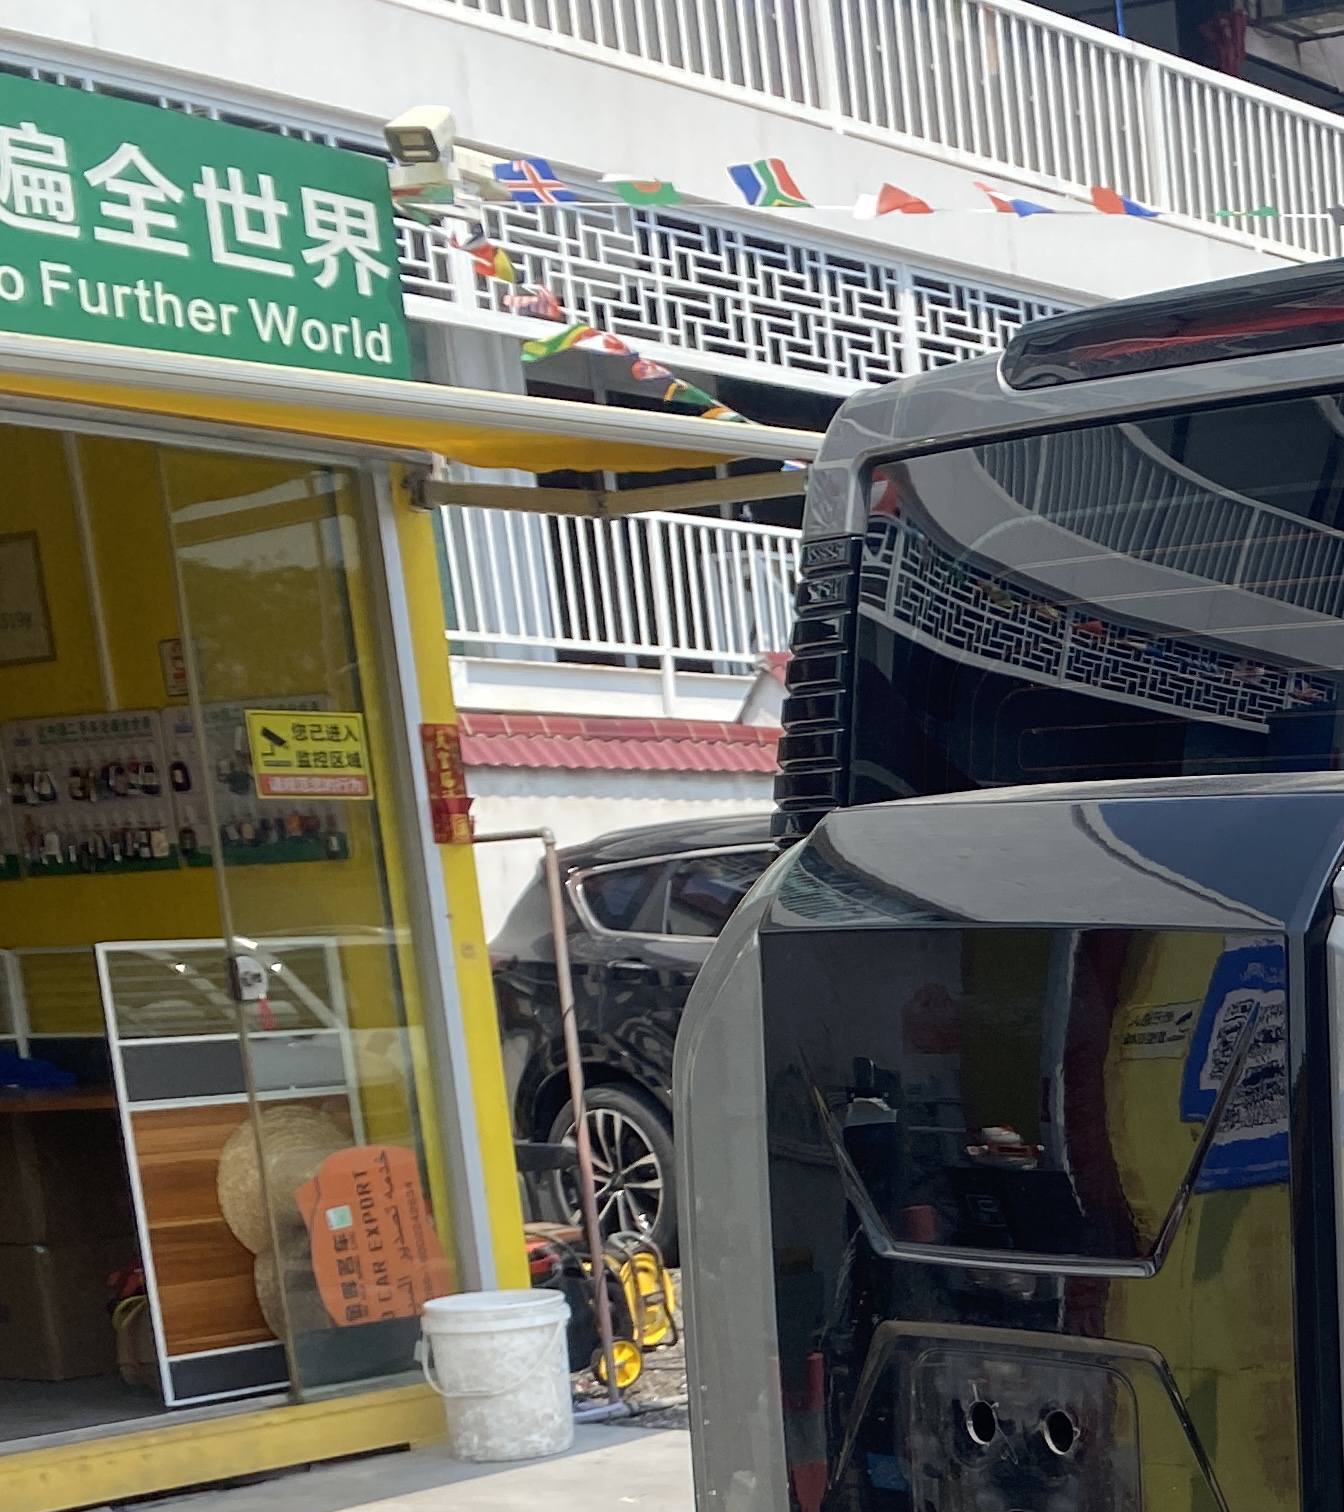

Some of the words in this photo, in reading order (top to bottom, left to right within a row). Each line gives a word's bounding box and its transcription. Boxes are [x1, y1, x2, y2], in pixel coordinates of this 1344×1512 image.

[39, 260, 239, 336] Further
[248, 298, 394, 364] World
[352, 1169, 384, 1253] EXPORT
[373, 1259, 394, 1303] CAR
